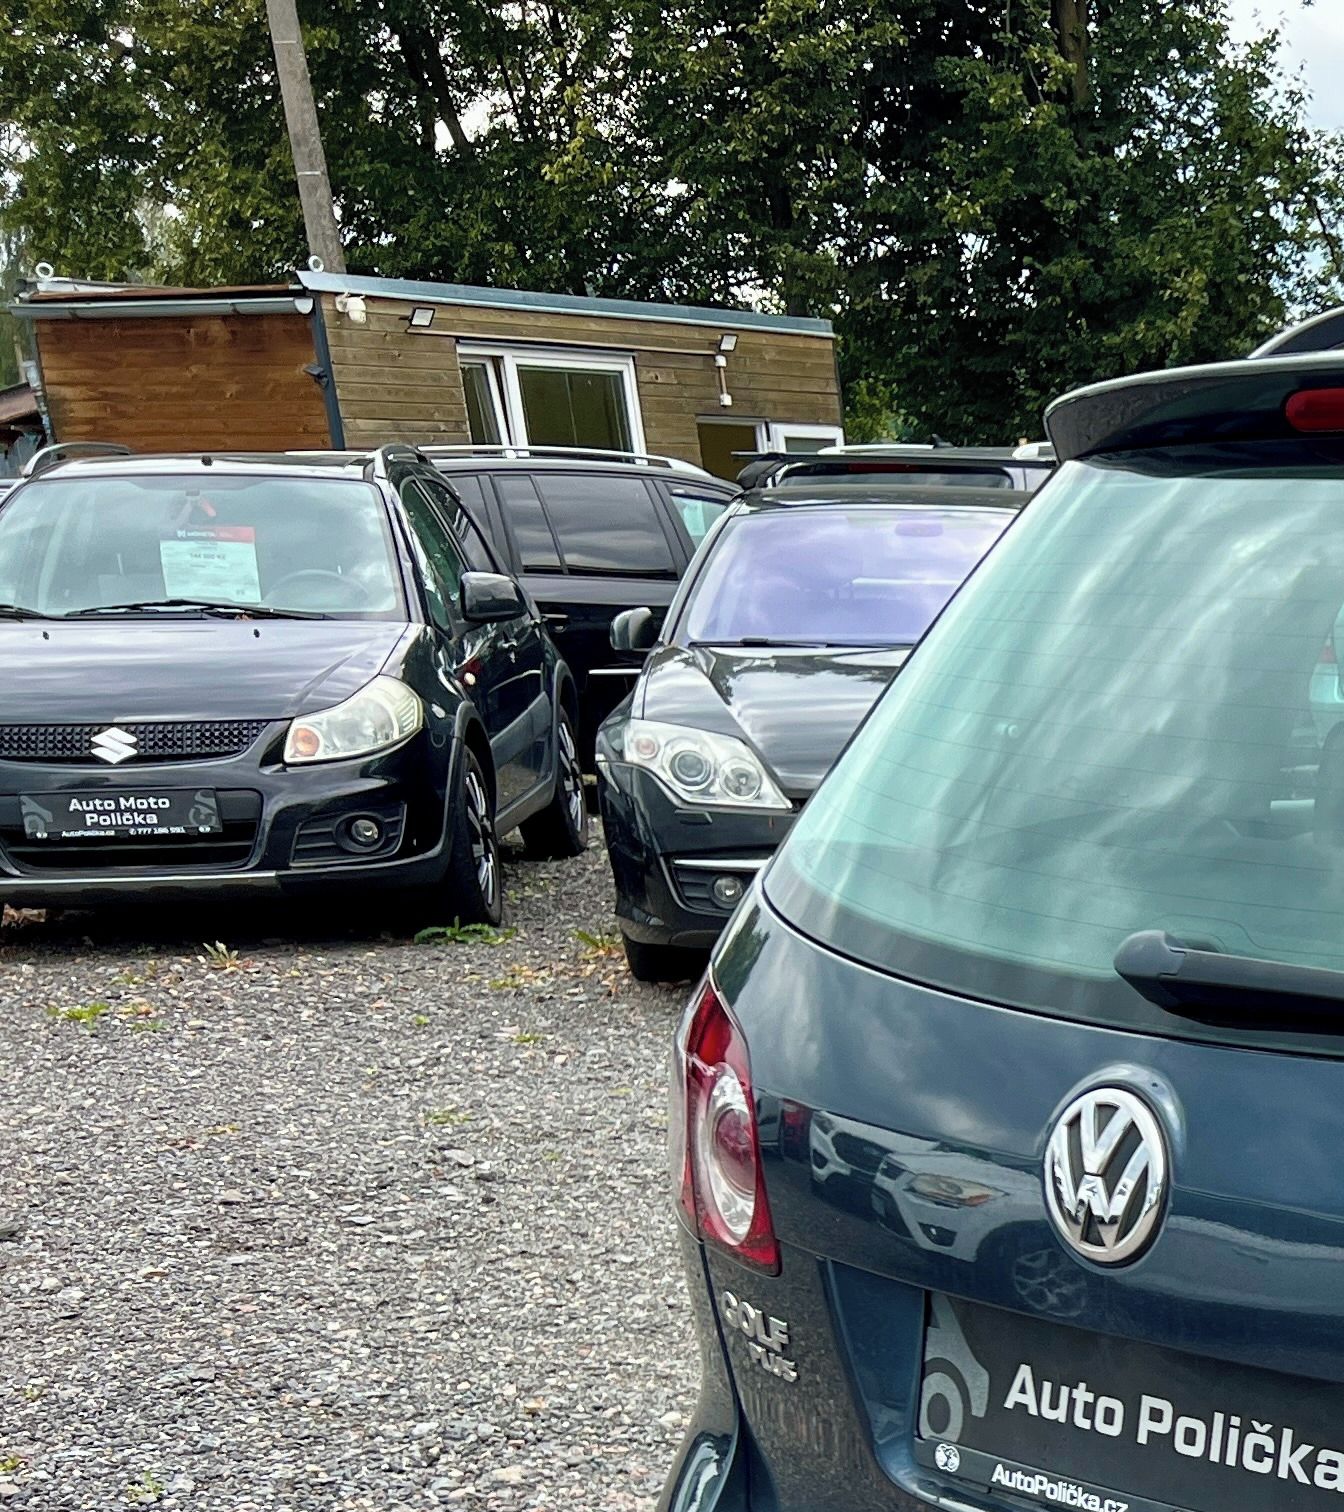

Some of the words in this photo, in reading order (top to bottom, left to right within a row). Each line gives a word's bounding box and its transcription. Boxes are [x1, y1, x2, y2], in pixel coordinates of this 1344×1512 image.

[69, 798, 116, 812] Auto
[119, 796, 171, 810] Moto
[85, 812, 158, 826] Polička
[721, 1291, 790, 1353] GOLF
[1003, 1363, 1125, 1438] Auto
